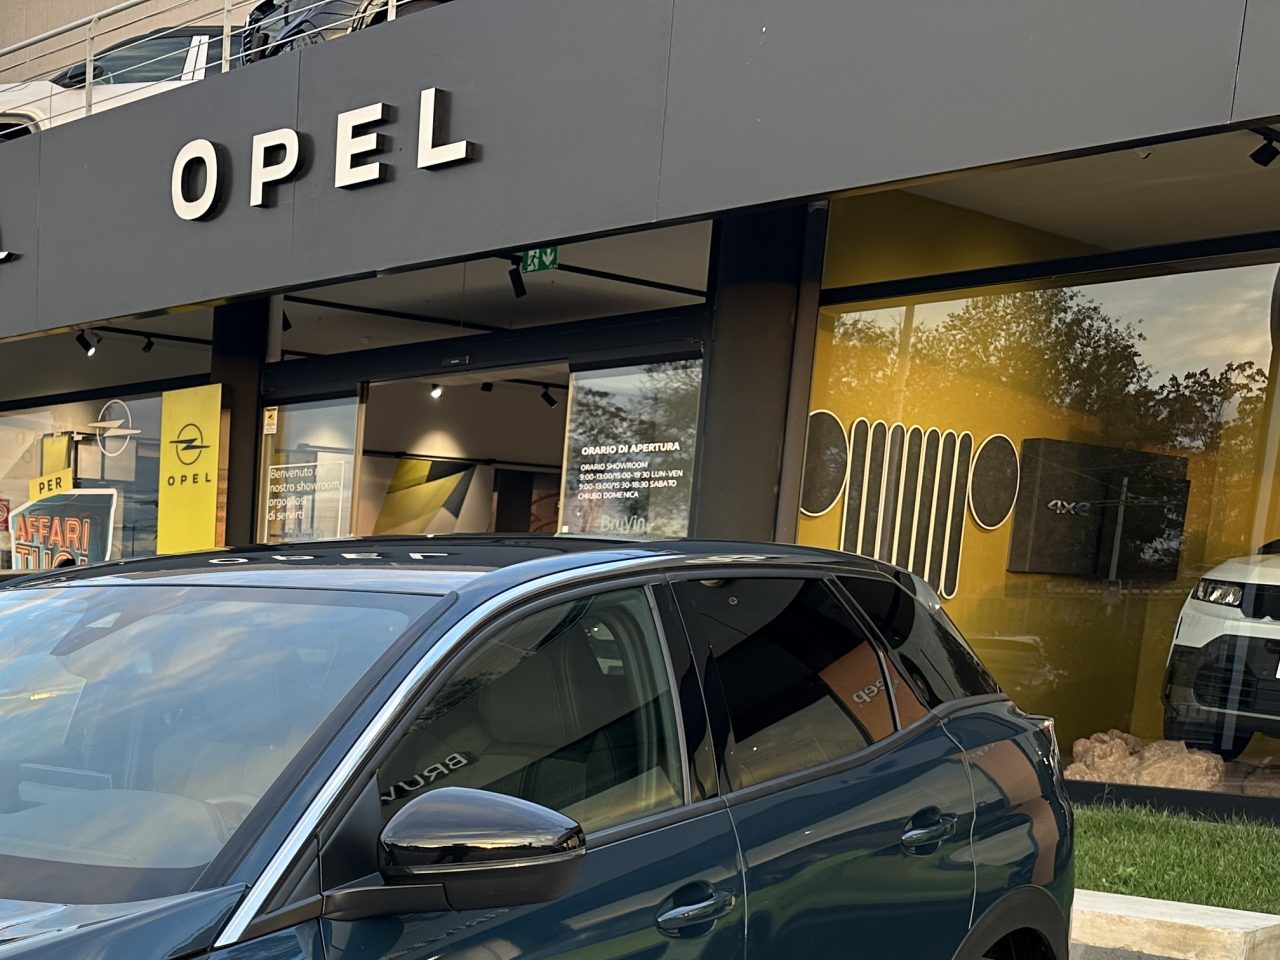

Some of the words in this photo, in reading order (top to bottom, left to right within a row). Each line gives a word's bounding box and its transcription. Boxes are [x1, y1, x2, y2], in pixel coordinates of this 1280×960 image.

[171, 87, 468, 221] OPEL
[581, 445, 617, 456] ORARIO
[618, 445, 628, 454] DI
[630, 442, 680, 453] APERTURA
[580, 463, 605, 471] ORARIO
[606, 461, 648, 470] SHOWROOM
[167, 472, 211, 486] OPEL
[270, 467, 313, 479] Benvenuto
[651, 469, 683, 478] LUN-VEN
[38, 476, 63, 494] PER
[269, 481, 295, 492] nostro
[650, 479, 677, 488] SABATO
[578, 492, 602, 500] CHIUSO
[603, 490, 639, 499] DOMENICA
[268, 495, 307, 508] orgogliosi
[267, 510, 276, 520] di
[276, 508, 305, 520] servirti
[15, 514, 91, 552] AFFARI
